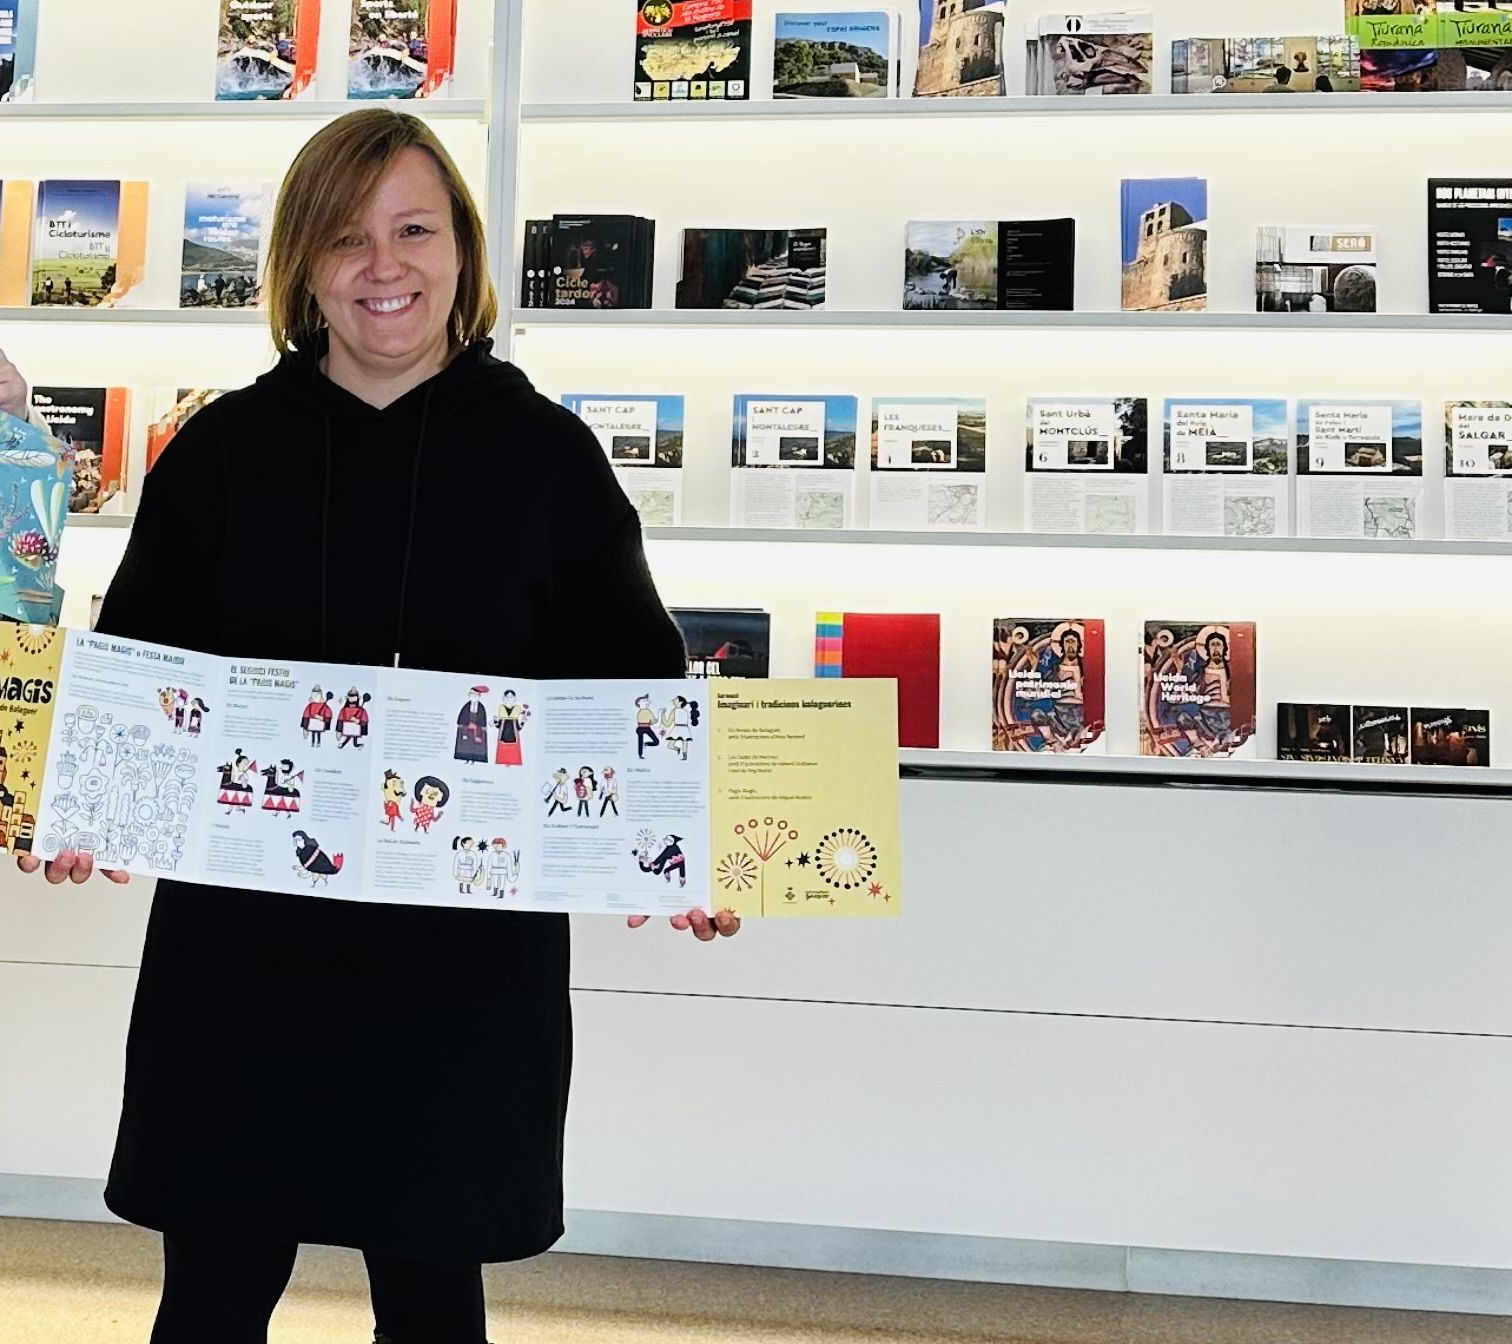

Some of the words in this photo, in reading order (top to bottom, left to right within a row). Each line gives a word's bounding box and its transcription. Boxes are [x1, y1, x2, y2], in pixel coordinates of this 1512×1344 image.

[556, 276, 589, 288] Cicle
[33, 394, 53, 405] The
[753, 406, 780, 414] SANT
[782, 406, 804, 414] CAP
[1040, 409, 1063, 418] Sant
[1458, 431, 1506, 439] SALGAR
[1039, 453, 1048, 462] 6
[1315, 457, 1325, 468] 9
[1161, 681, 1197, 692] World
